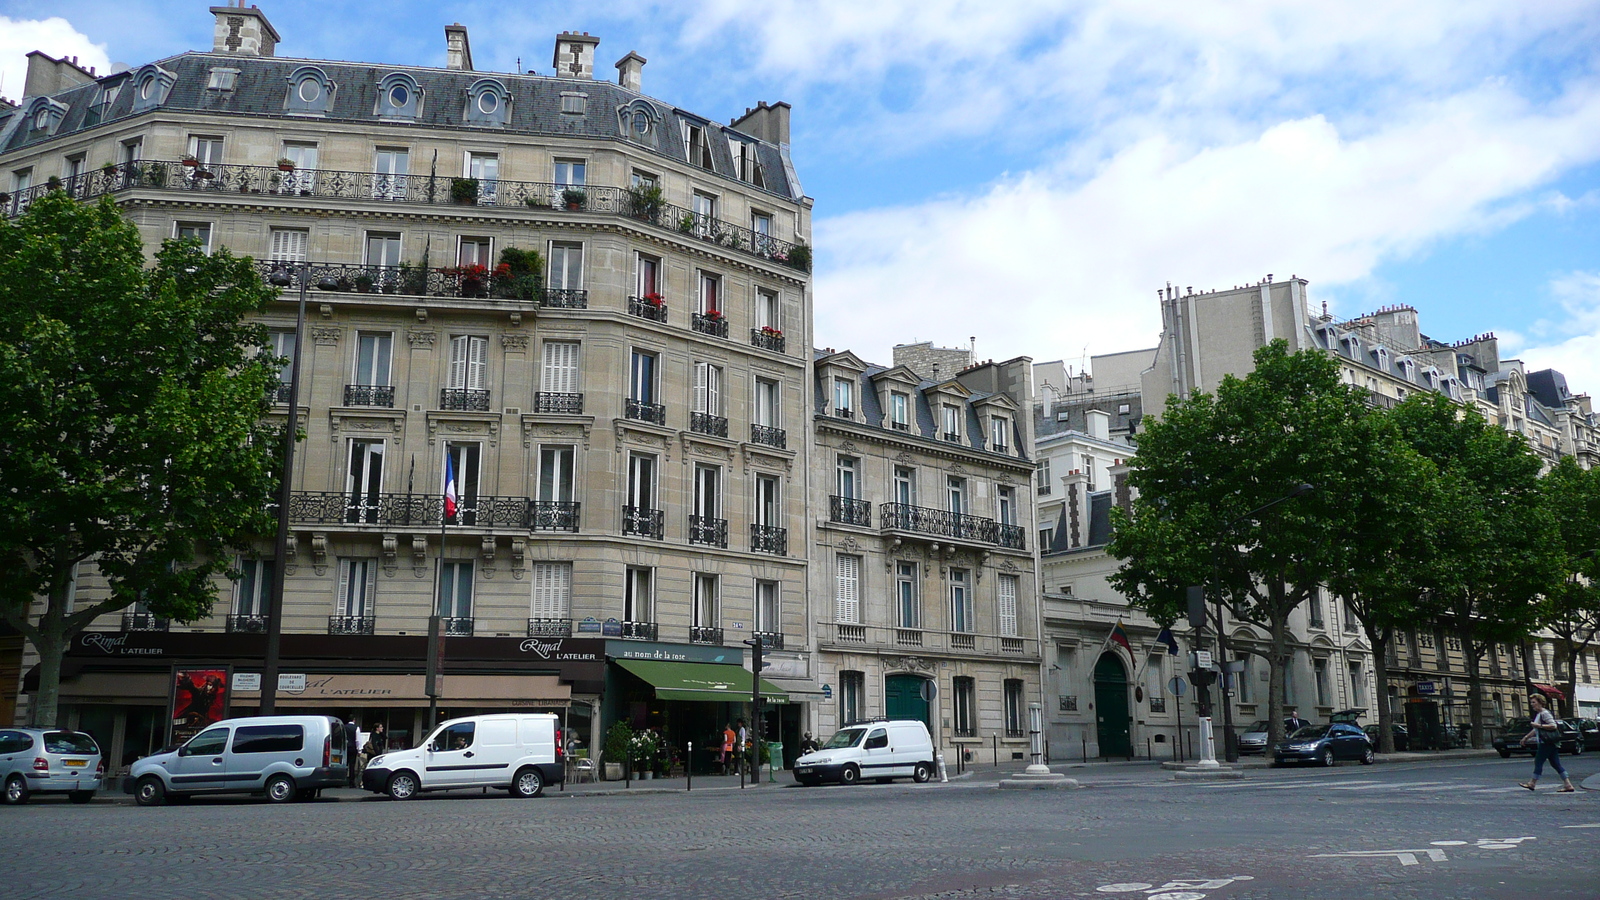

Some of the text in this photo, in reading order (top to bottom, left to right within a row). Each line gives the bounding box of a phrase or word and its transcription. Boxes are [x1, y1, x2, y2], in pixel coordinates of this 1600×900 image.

[81, 632, 129, 654] Rimal
[519, 638, 563, 659] Rimal
[653, 649, 663, 659] de
[664, 650, 671, 660] la
